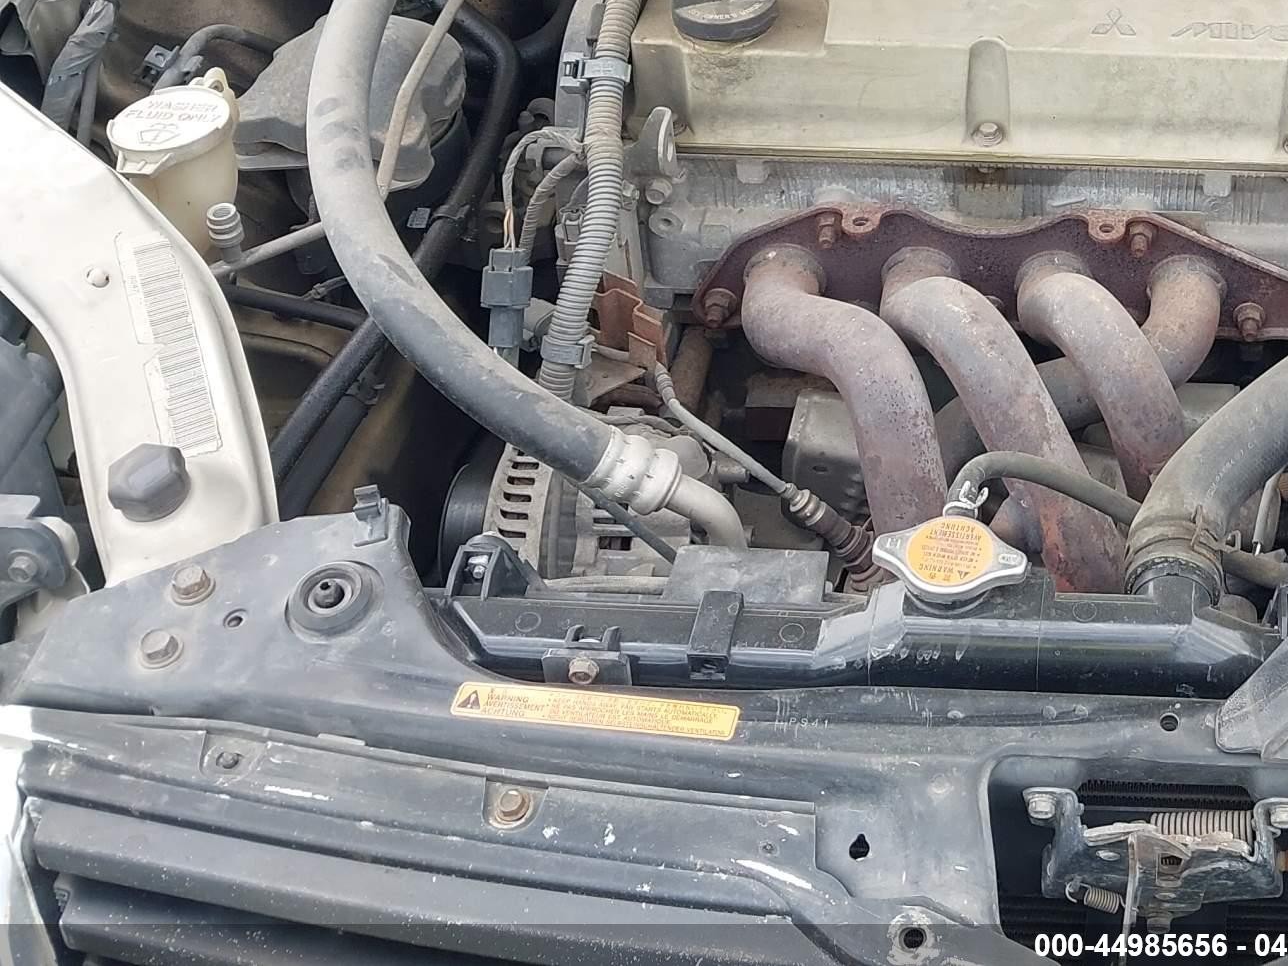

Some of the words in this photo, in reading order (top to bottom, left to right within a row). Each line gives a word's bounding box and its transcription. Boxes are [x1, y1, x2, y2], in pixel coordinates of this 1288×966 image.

[147, 100, 218, 112] WASHER
[125, 109, 174, 121] FLUID
[178, 114, 222, 123] ONLY
[929, 528, 982, 542] AVERTISSEMENT
[918, 562, 955, 575] WARNING
[484, 698, 544, 711] AVERTISSEMENT
[487, 693, 529, 703] WARNING
[481, 706, 525, 717] ACHTUNG
